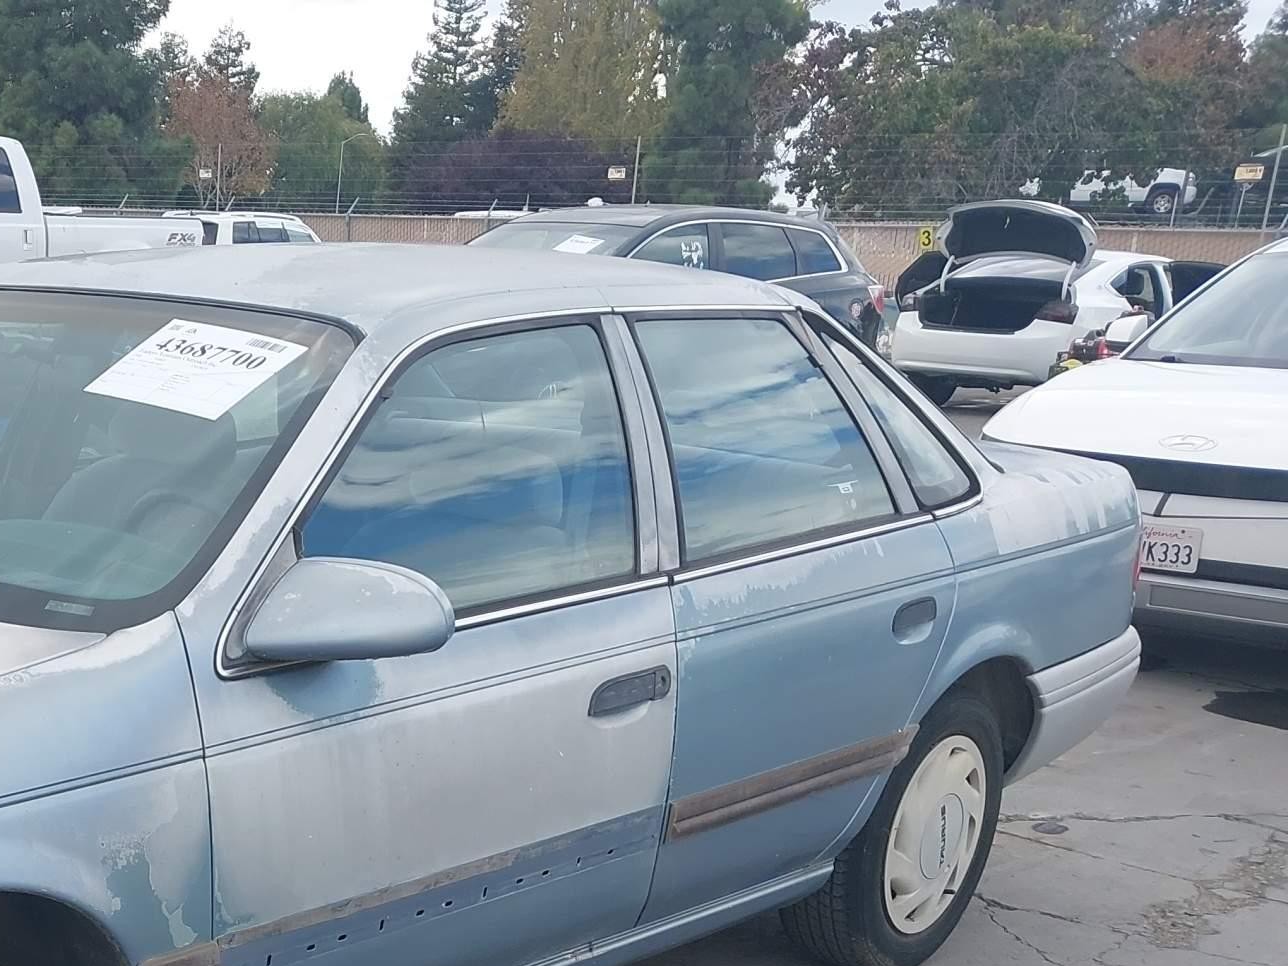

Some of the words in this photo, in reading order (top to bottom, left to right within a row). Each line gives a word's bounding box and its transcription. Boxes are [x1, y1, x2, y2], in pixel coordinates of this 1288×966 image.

[167, 232, 196, 243] FX4
[922, 230, 932, 246] 3
[156, 337, 267, 370] 43687700
[1142, 540, 1193, 565] K333
[938, 804, 947, 869] TAURUS
